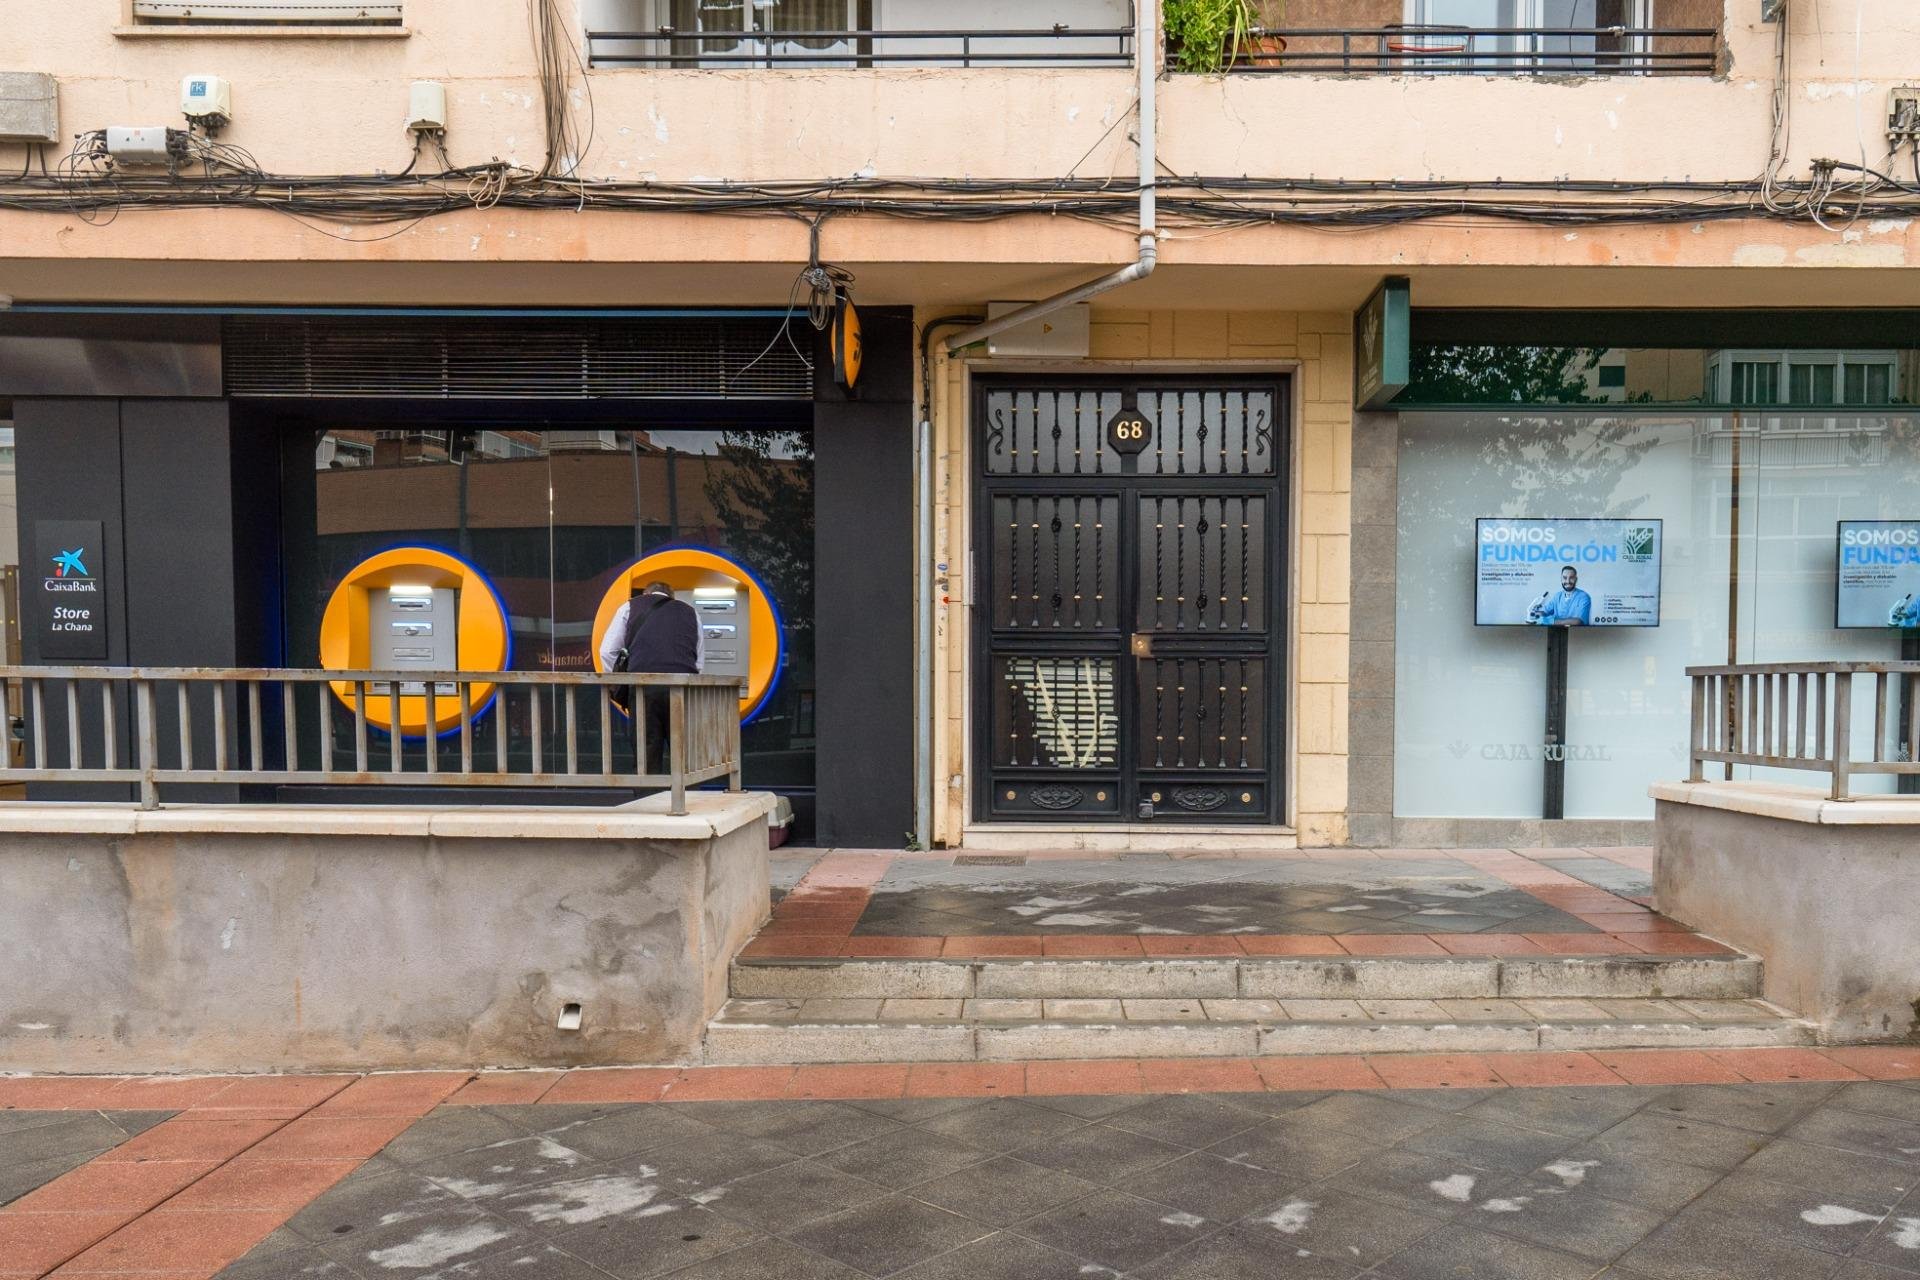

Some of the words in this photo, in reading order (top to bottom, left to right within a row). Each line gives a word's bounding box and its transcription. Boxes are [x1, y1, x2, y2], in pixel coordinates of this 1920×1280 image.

[1117, 420, 1143, 439] 68
[1481, 527, 1556, 543] SOMOS
[1843, 529, 1919, 546] SOMOS
[1481, 540, 1618, 562] FUNDACIÓN
[44, 580, 97, 592] CaixaBank
[53, 606, 90, 619] Store
[52, 623, 62, 632] La
[64, 622, 93, 632] Chana
[1480, 744, 1532, 761] CAJA
[1535, 744, 1612, 761] RURAL
